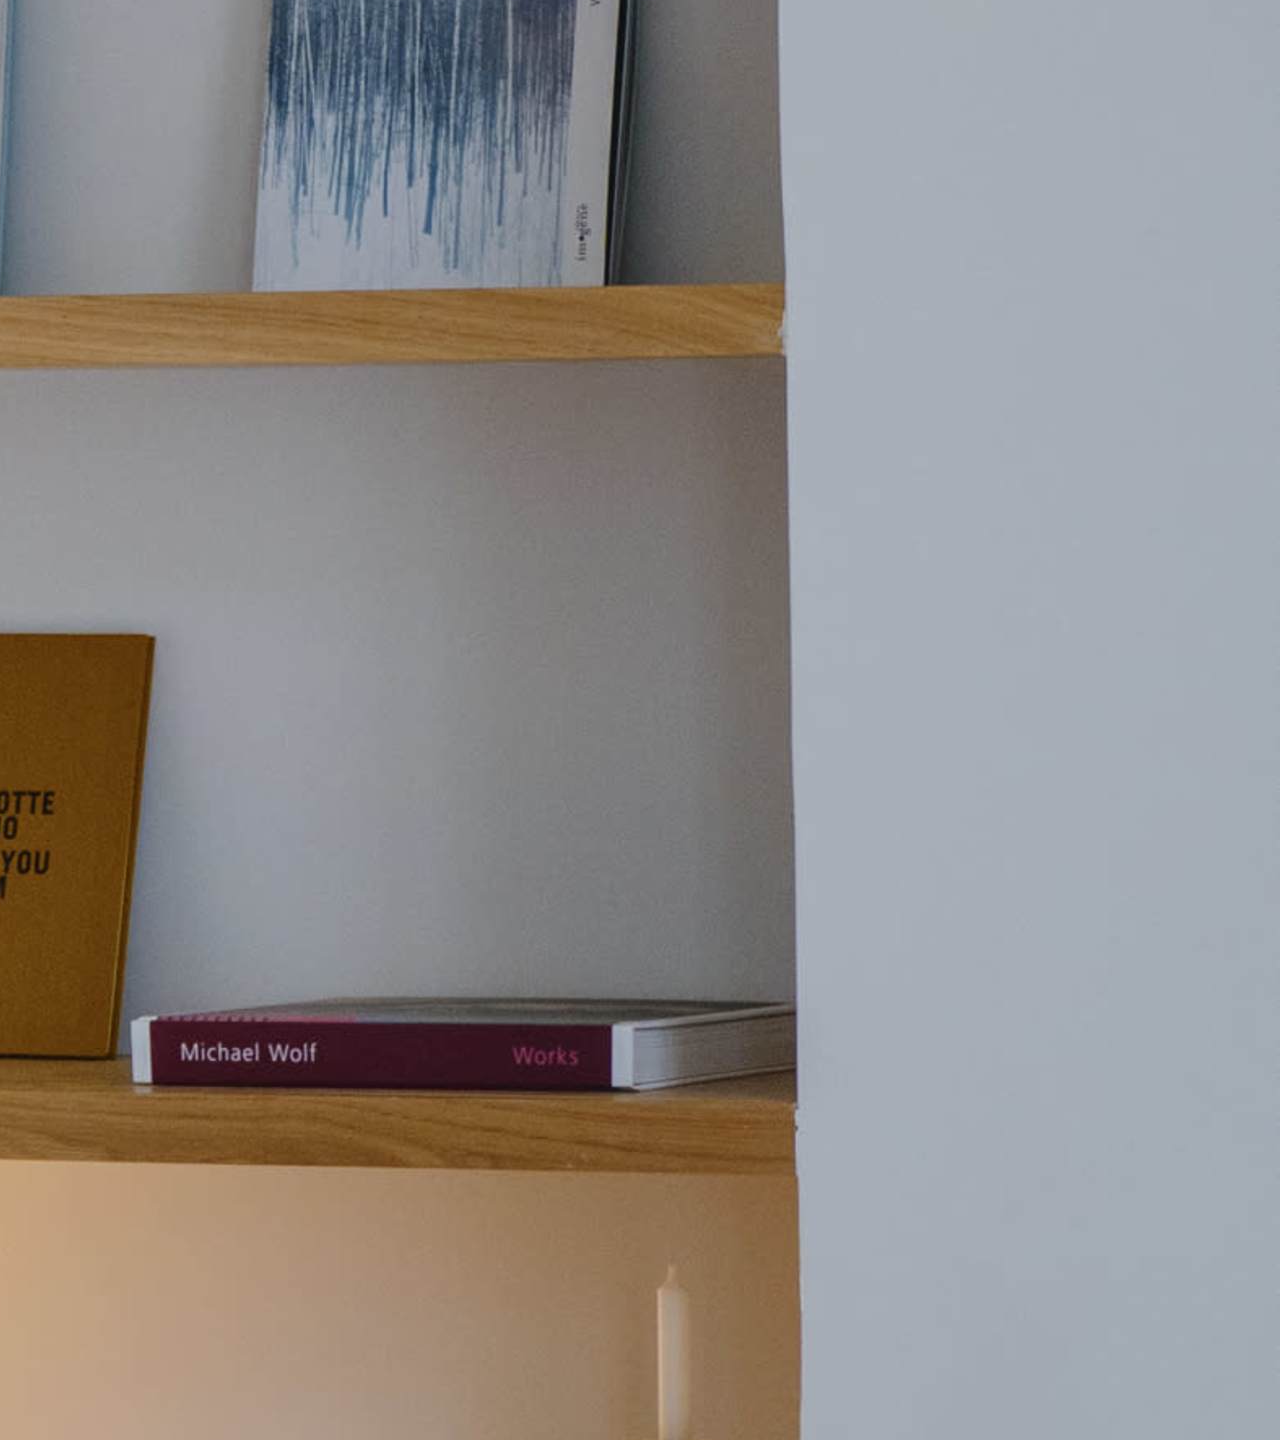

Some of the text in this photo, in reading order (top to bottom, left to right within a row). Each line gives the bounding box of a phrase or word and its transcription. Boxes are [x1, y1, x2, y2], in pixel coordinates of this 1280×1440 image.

[1, 850, 50, 875] YOU
[180, 1042, 318, 1063] Michael Wolf
[513, 1046, 579, 1066] Works
